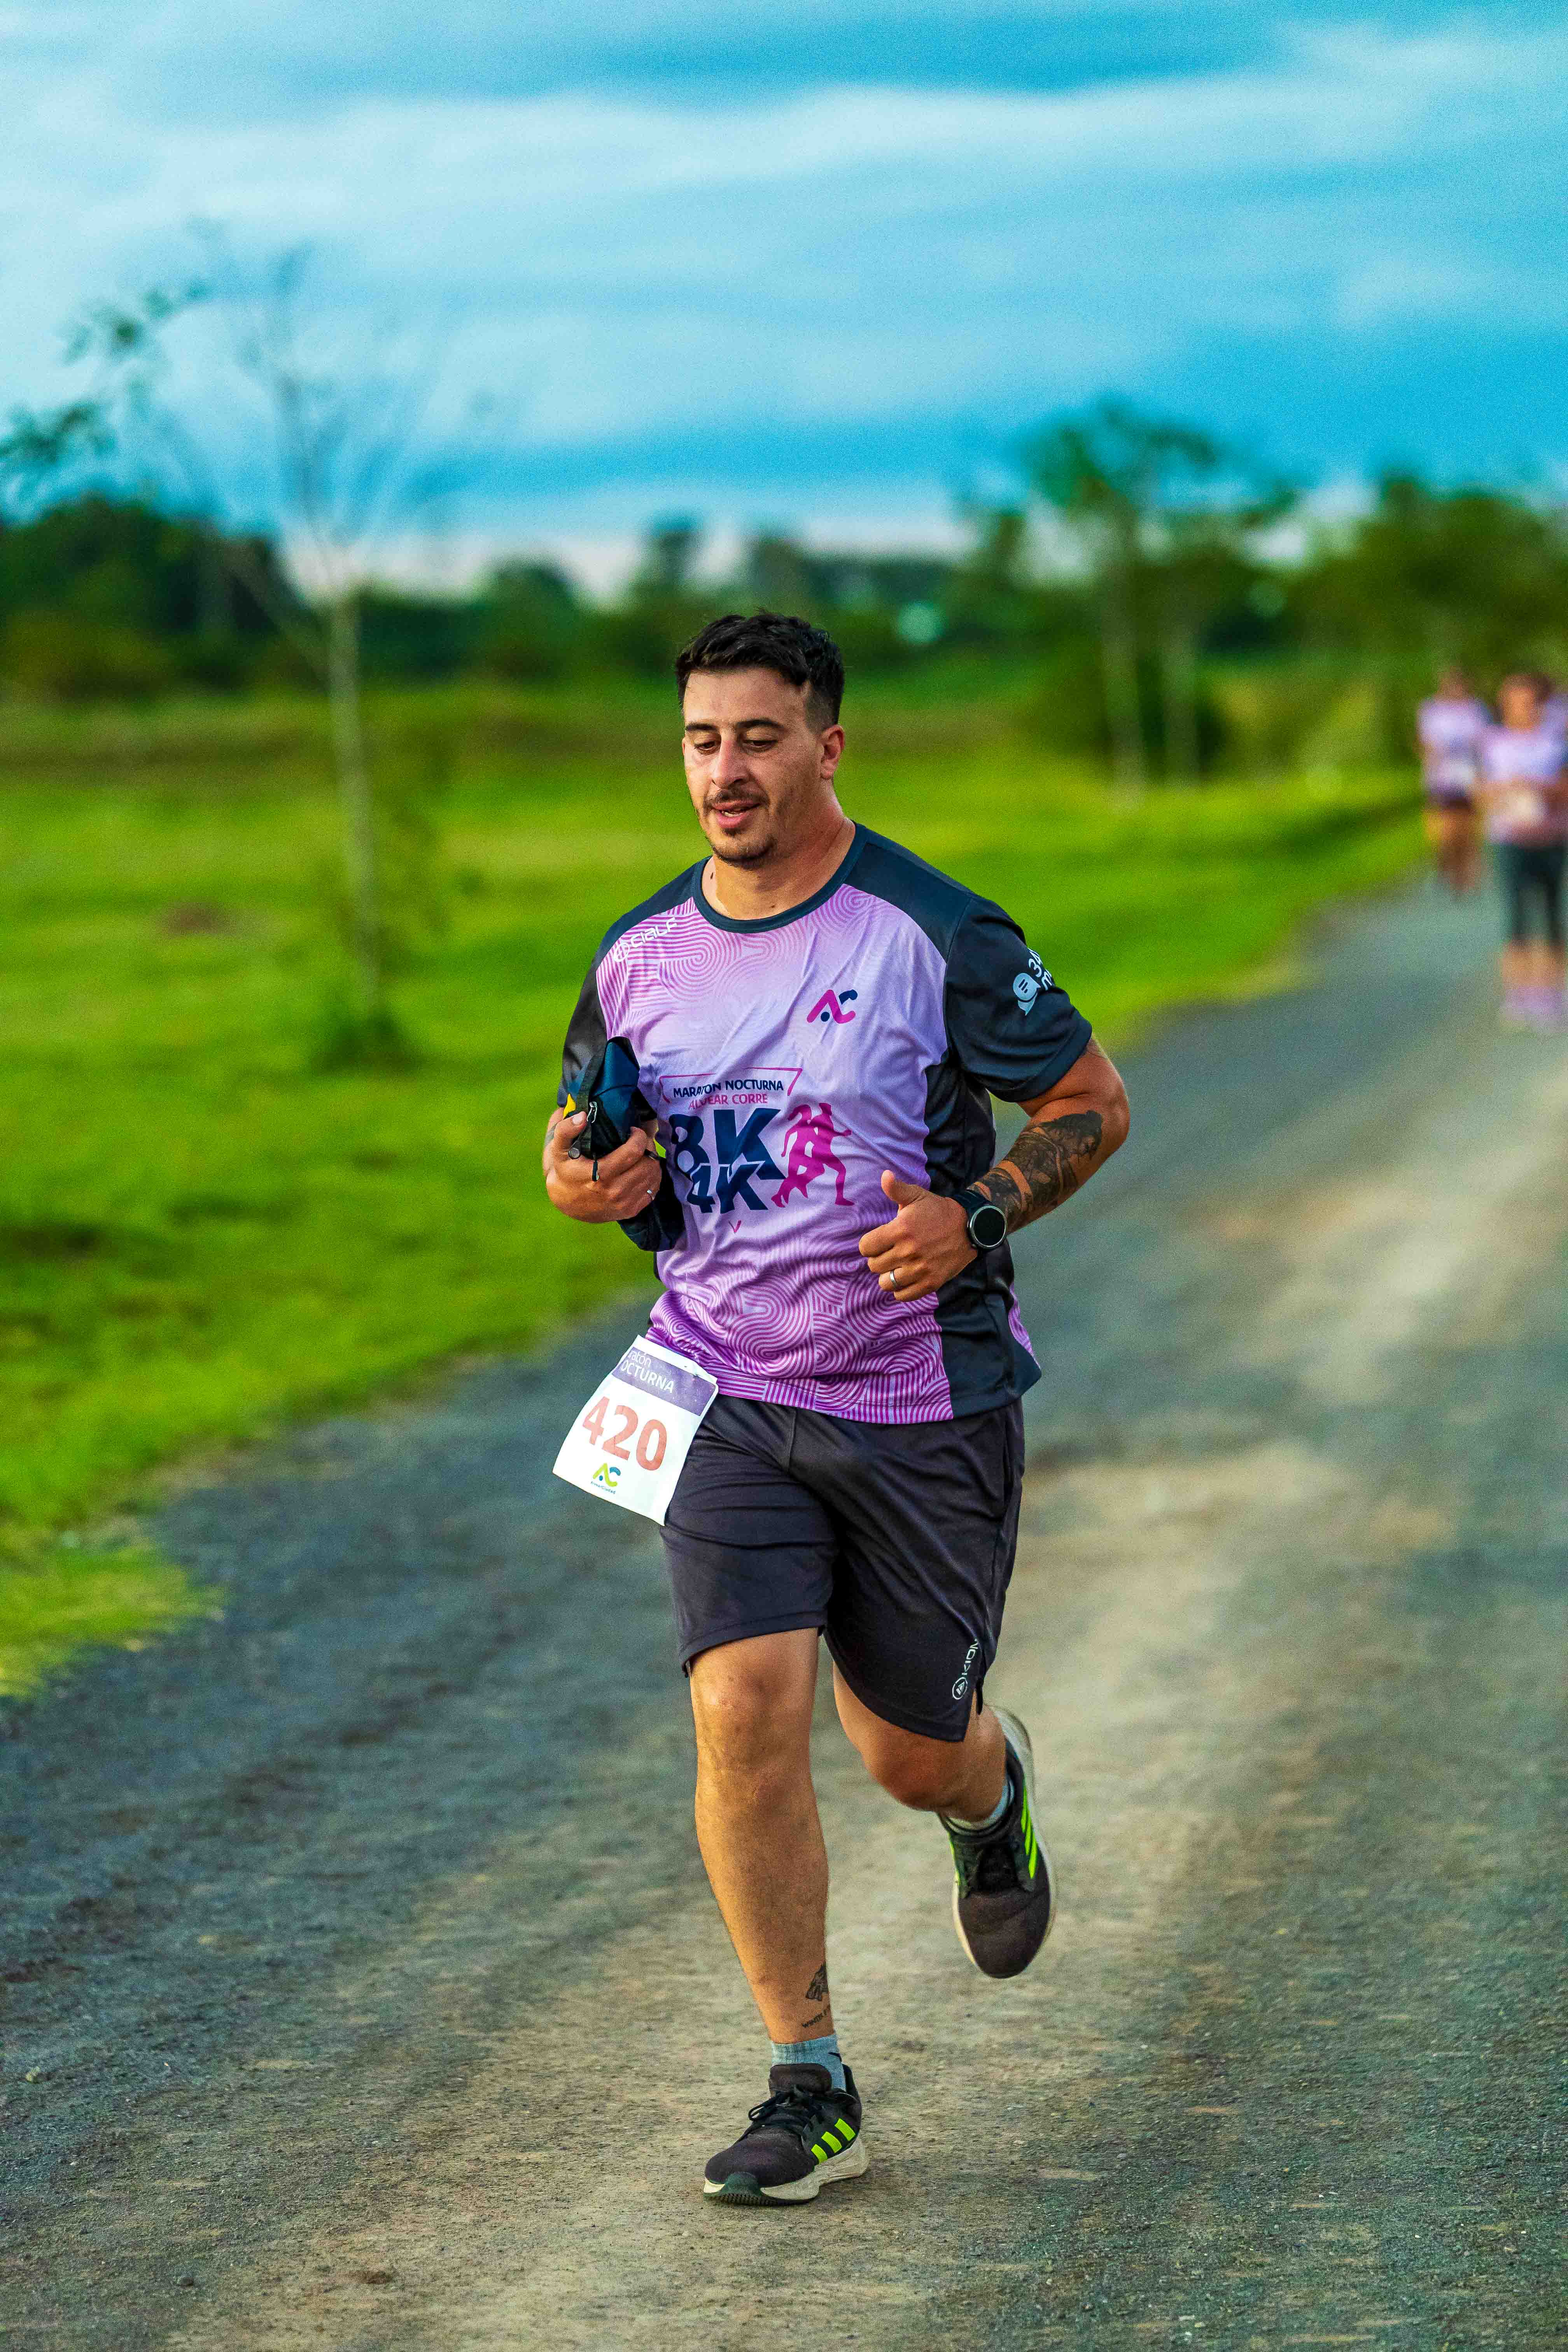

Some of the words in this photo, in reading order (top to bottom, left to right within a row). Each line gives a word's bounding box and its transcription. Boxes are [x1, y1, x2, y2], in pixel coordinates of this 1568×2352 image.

[725, 1079, 784, 1091] NOCTURNA
[732, 1093, 769, 1105] CORRE
[668, 1108, 786, 1181] 8K
[686, 1165, 769, 1214] 4K
[582, 1396, 667, 1471] 420
